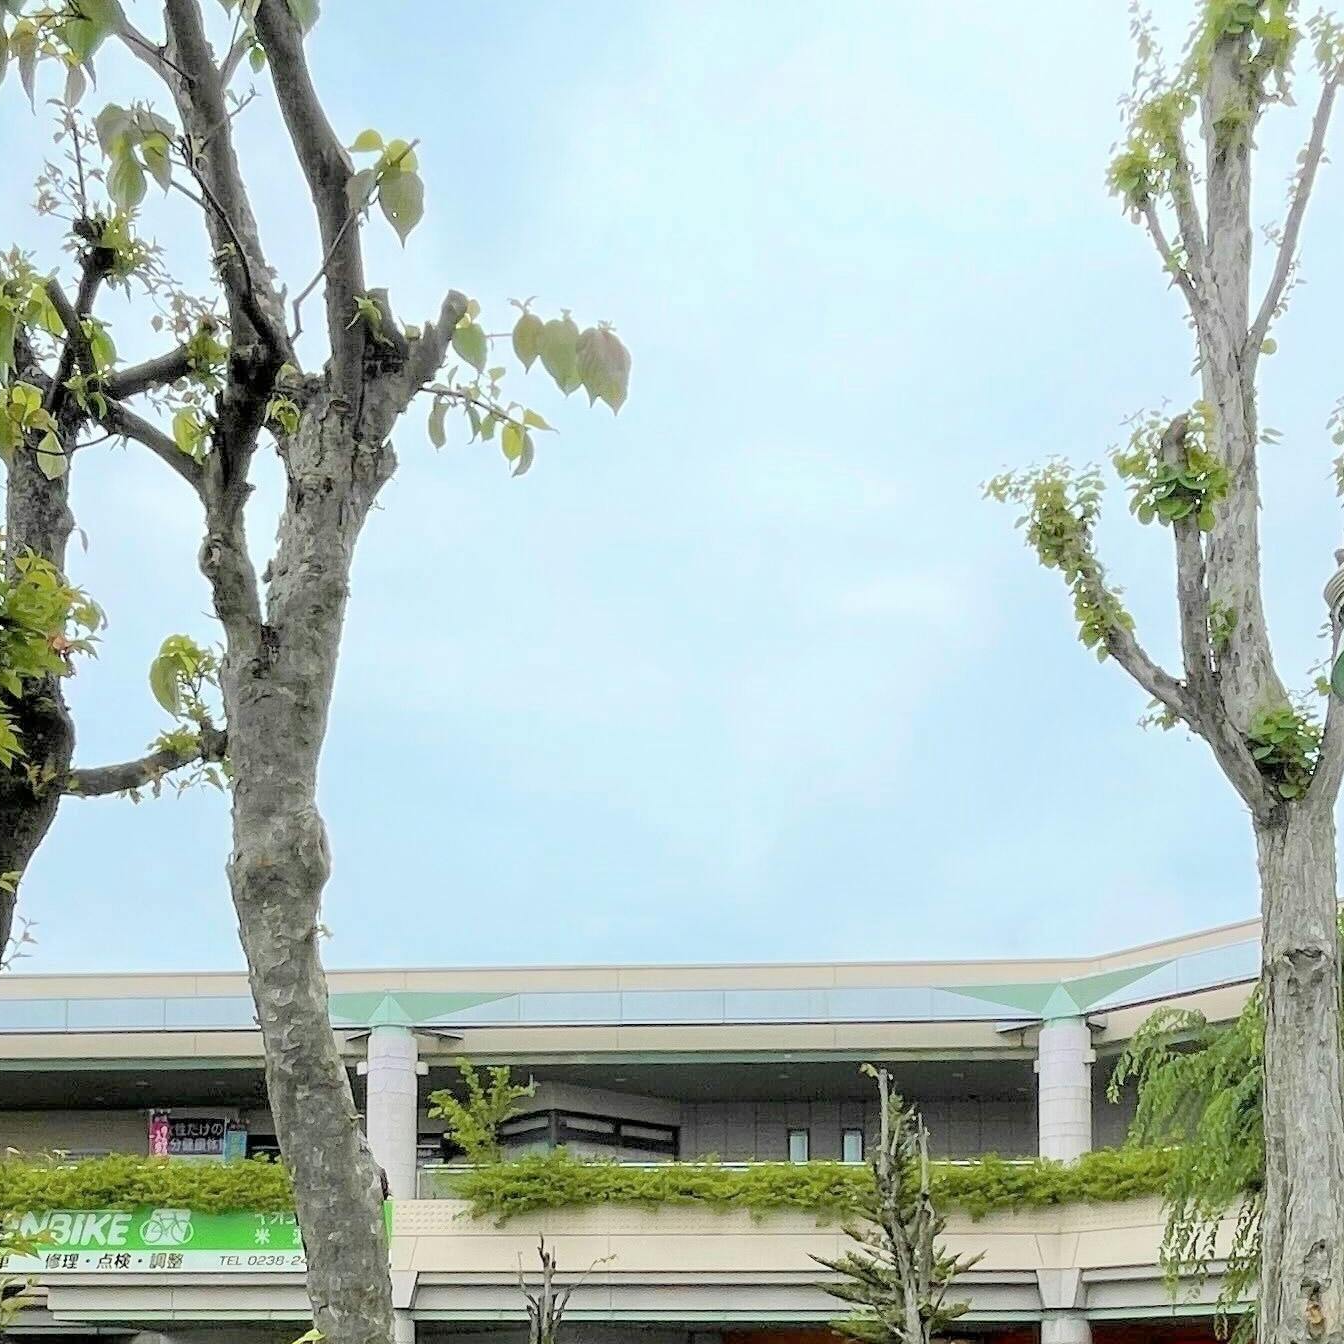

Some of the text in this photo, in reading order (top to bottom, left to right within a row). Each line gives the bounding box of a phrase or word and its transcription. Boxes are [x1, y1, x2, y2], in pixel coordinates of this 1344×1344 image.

[45, 1252, 185, 1270] 修理・点検・調整
[220, 1255, 243, 1266] TEL
